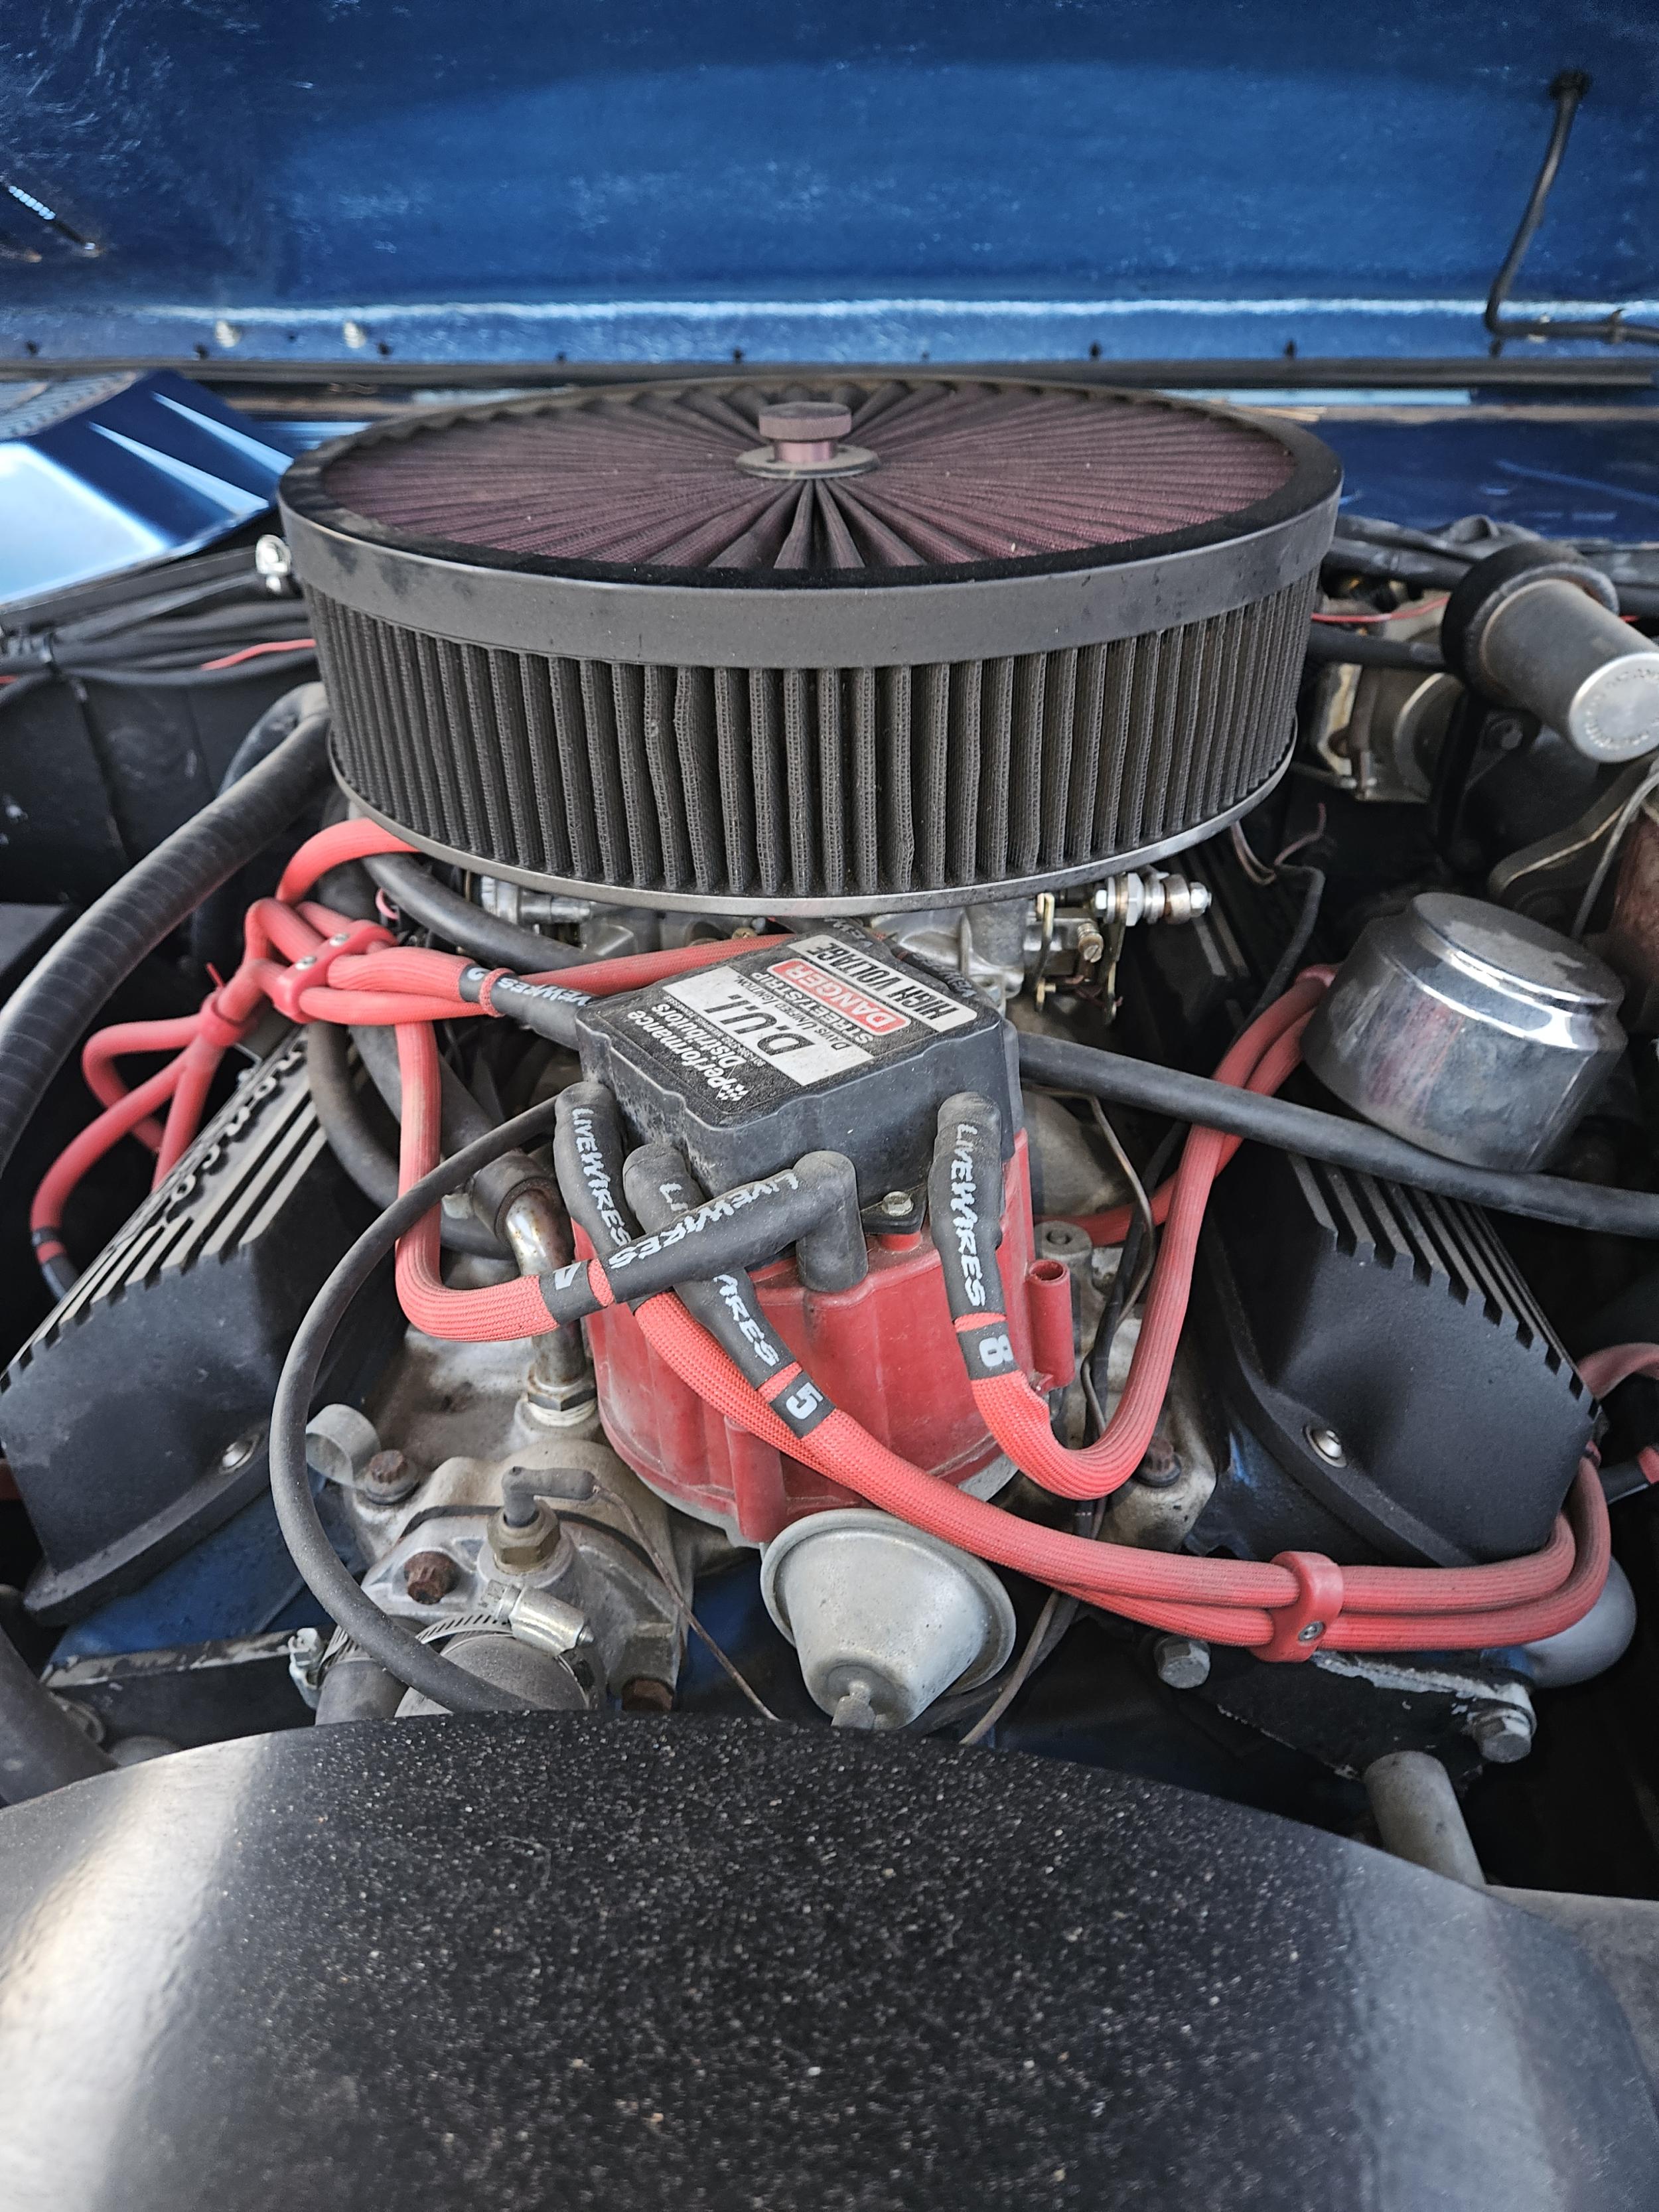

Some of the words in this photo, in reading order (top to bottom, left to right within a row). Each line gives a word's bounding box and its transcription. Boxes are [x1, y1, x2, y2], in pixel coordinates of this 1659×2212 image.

[786, 964, 896, 1029] DANGER
[806, 941, 903, 993] VOLTAGE
[703, 994, 816, 1056] D.U.I.
[751, 971, 874, 1045] STREET/STRIP
[773, 1001, 818, 1031] UNIFIED
[887, 984, 960, 1021] HIGH
[626, 1009, 737, 1089] Performance
[651, 1002, 747, 1069] Distributors
[814, 1027, 853, 1051] DAVIS
[571, 1107, 631, 1247] LIVEWIRES
[608, 1171, 799, 1270] LIVEWIRES
[950, 1123, 987, 1307] LIVEWIRES
[978, 1333, 1015, 1368] 8
[785, 1381, 824, 1420] 5
